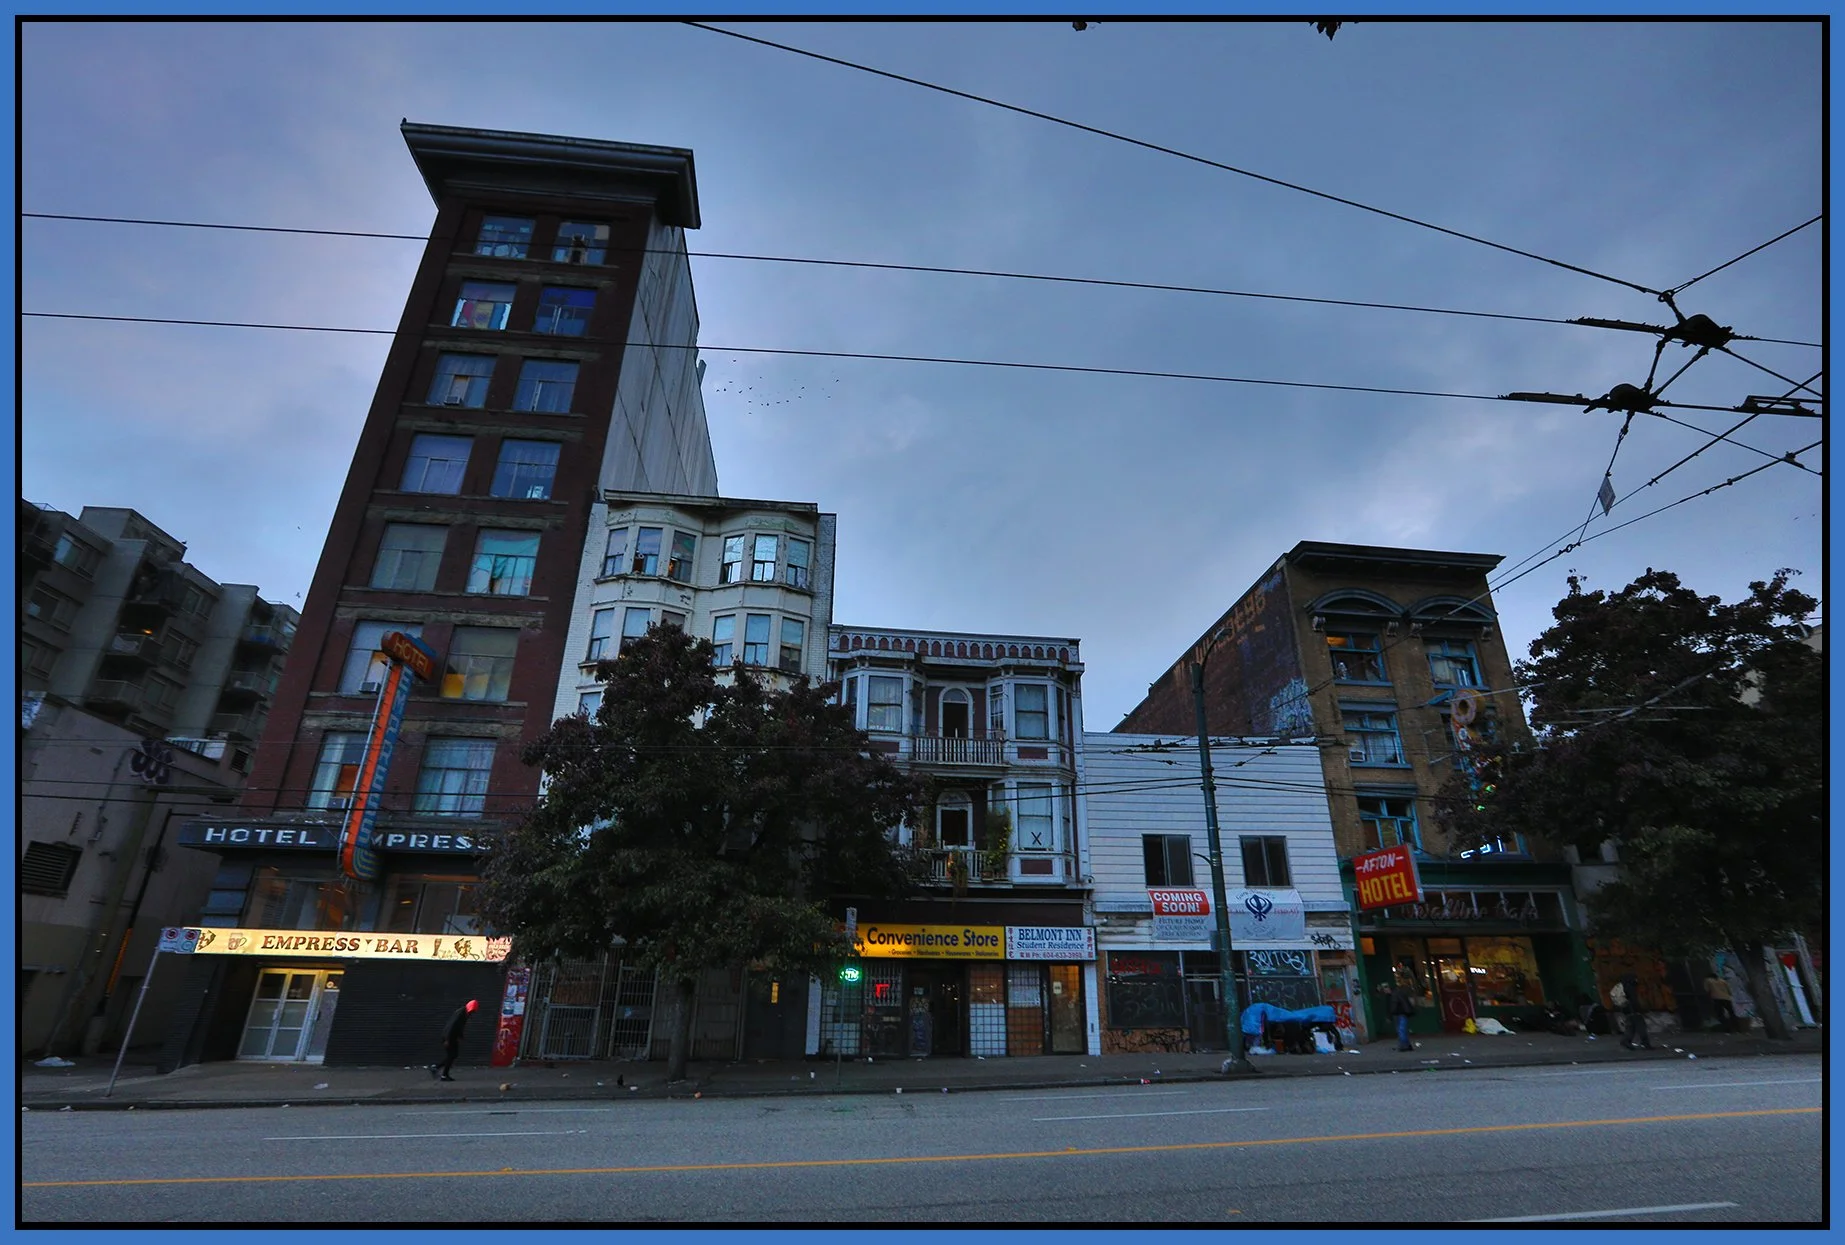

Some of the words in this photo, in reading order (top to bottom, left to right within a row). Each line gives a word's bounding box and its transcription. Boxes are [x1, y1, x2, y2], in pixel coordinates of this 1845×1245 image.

[394, 635, 428, 673] HOTEL
[205, 827, 318, 846] HOTEL
[343, 829, 494, 850] MPRESS
[1362, 853, 1396, 873] AFTON
[1153, 892, 1203, 902] COMING
[1360, 871, 1413, 905] HOTEL
[1162, 902, 1200, 913] SOON!
[867, 927, 959, 947] Convenience
[963, 928, 999, 947] Store
[1018, 928, 1063, 941] BELMONT
[1066, 929, 1082, 941] INN
[262, 935, 360, 952] EMPRESS
[374, 938, 419, 954] BAR
[1017, 941, 1046, 949] Student
[1048, 941, 1084, 949] Residence
